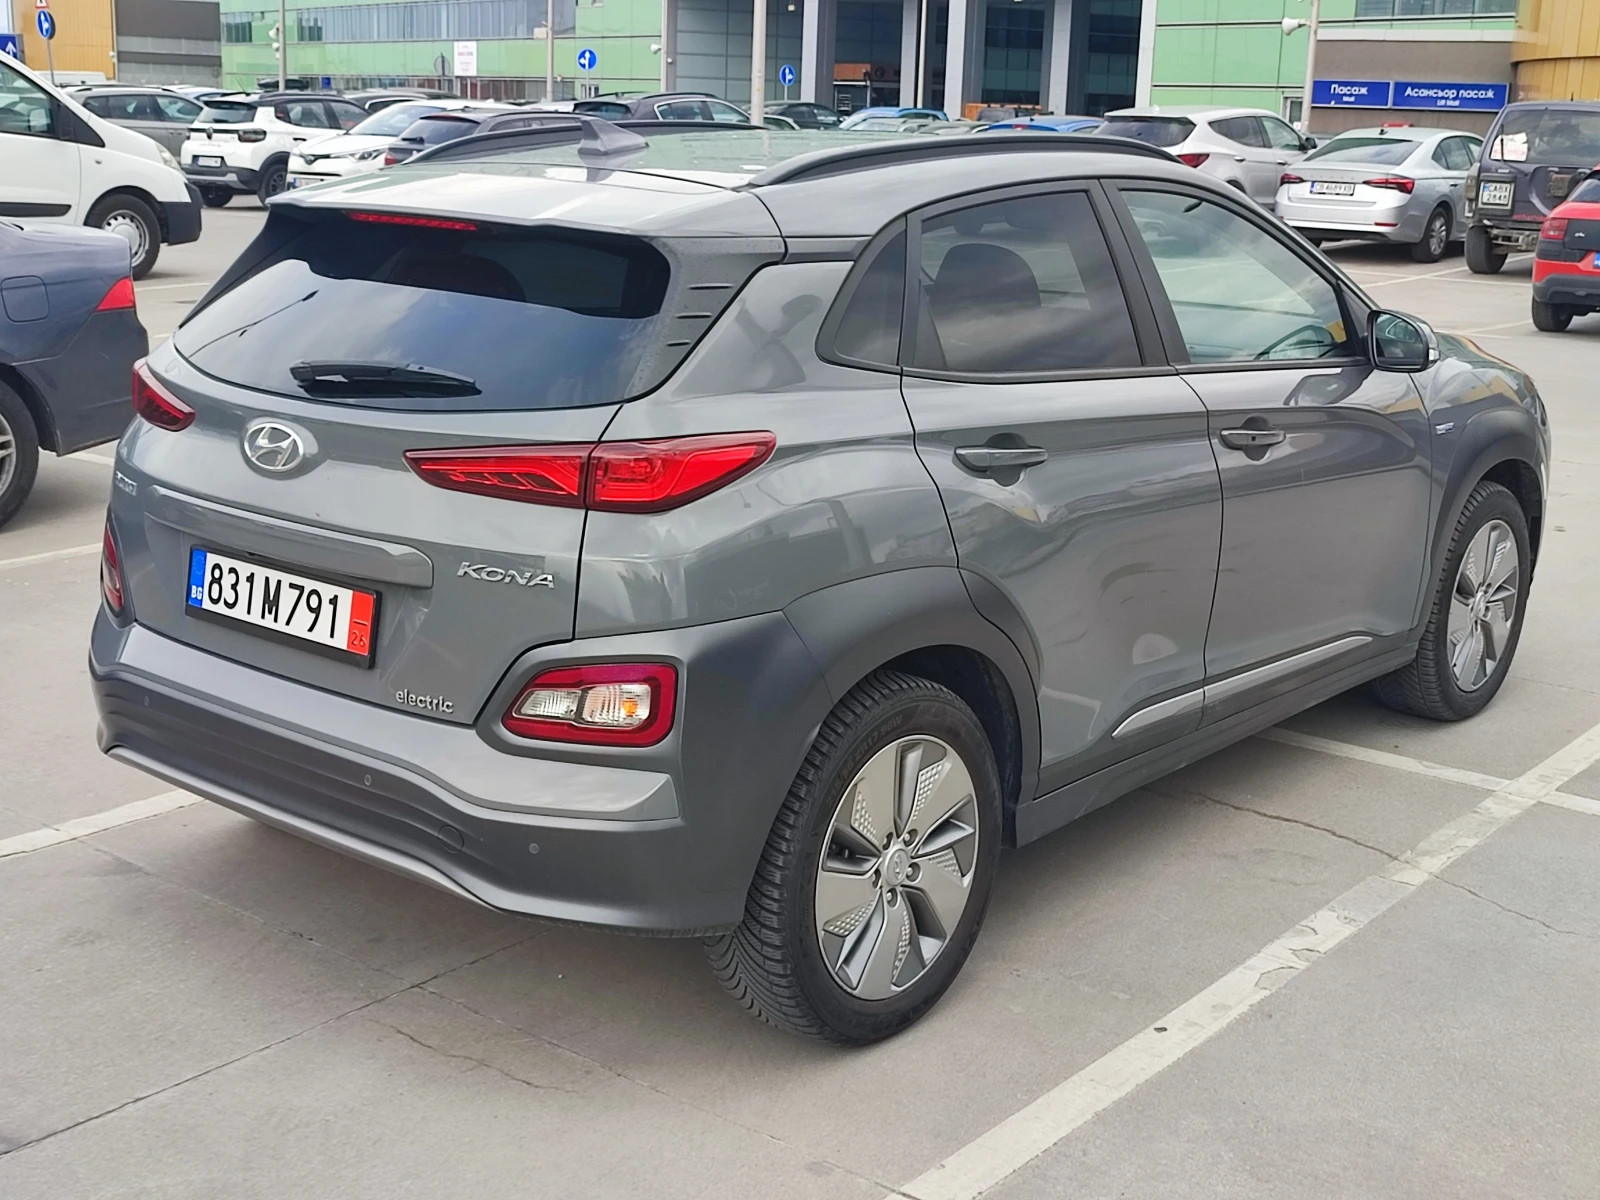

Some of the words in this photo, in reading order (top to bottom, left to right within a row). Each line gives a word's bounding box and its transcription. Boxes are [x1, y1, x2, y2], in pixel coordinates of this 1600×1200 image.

[1330, 83, 1368, 95] Пасаж
[1404, 86, 1457, 99] Асансьор
[1458, 88, 1495, 99] пасаж
[456, 561, 555, 589] KONA
[191, 585, 203, 600] BG
[207, 562, 339, 639] 831M791
[351, 631, 366, 648] 26
[395, 688, 454, 713] electric
